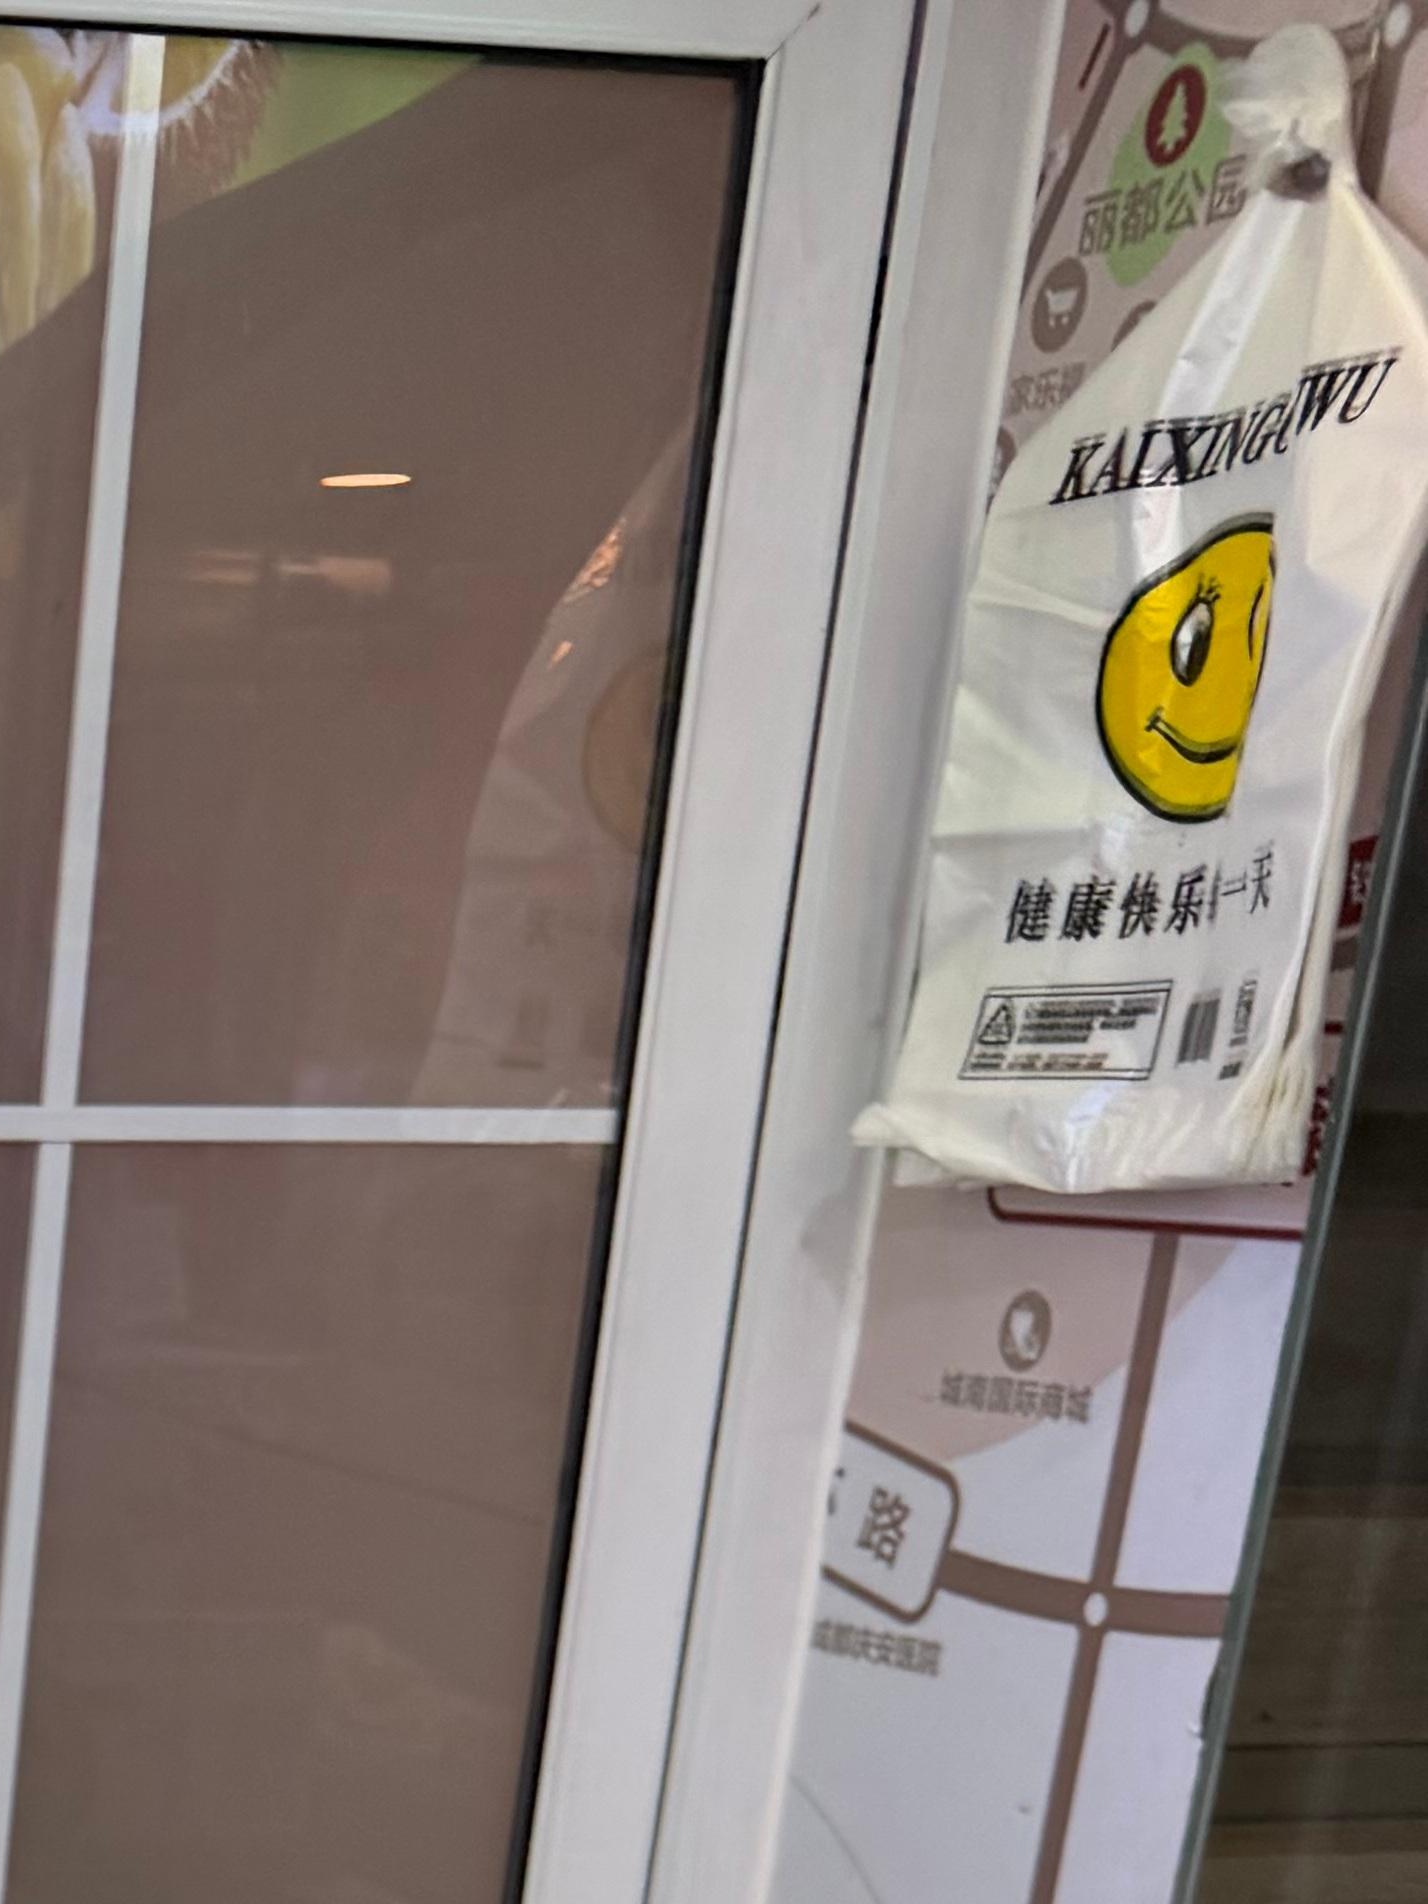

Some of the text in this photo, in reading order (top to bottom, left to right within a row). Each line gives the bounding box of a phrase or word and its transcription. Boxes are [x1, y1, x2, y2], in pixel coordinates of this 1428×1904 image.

[1079, 154, 1249, 257] 丽都公园
[1004, 848, 1273, 943] 健康快乐一天
